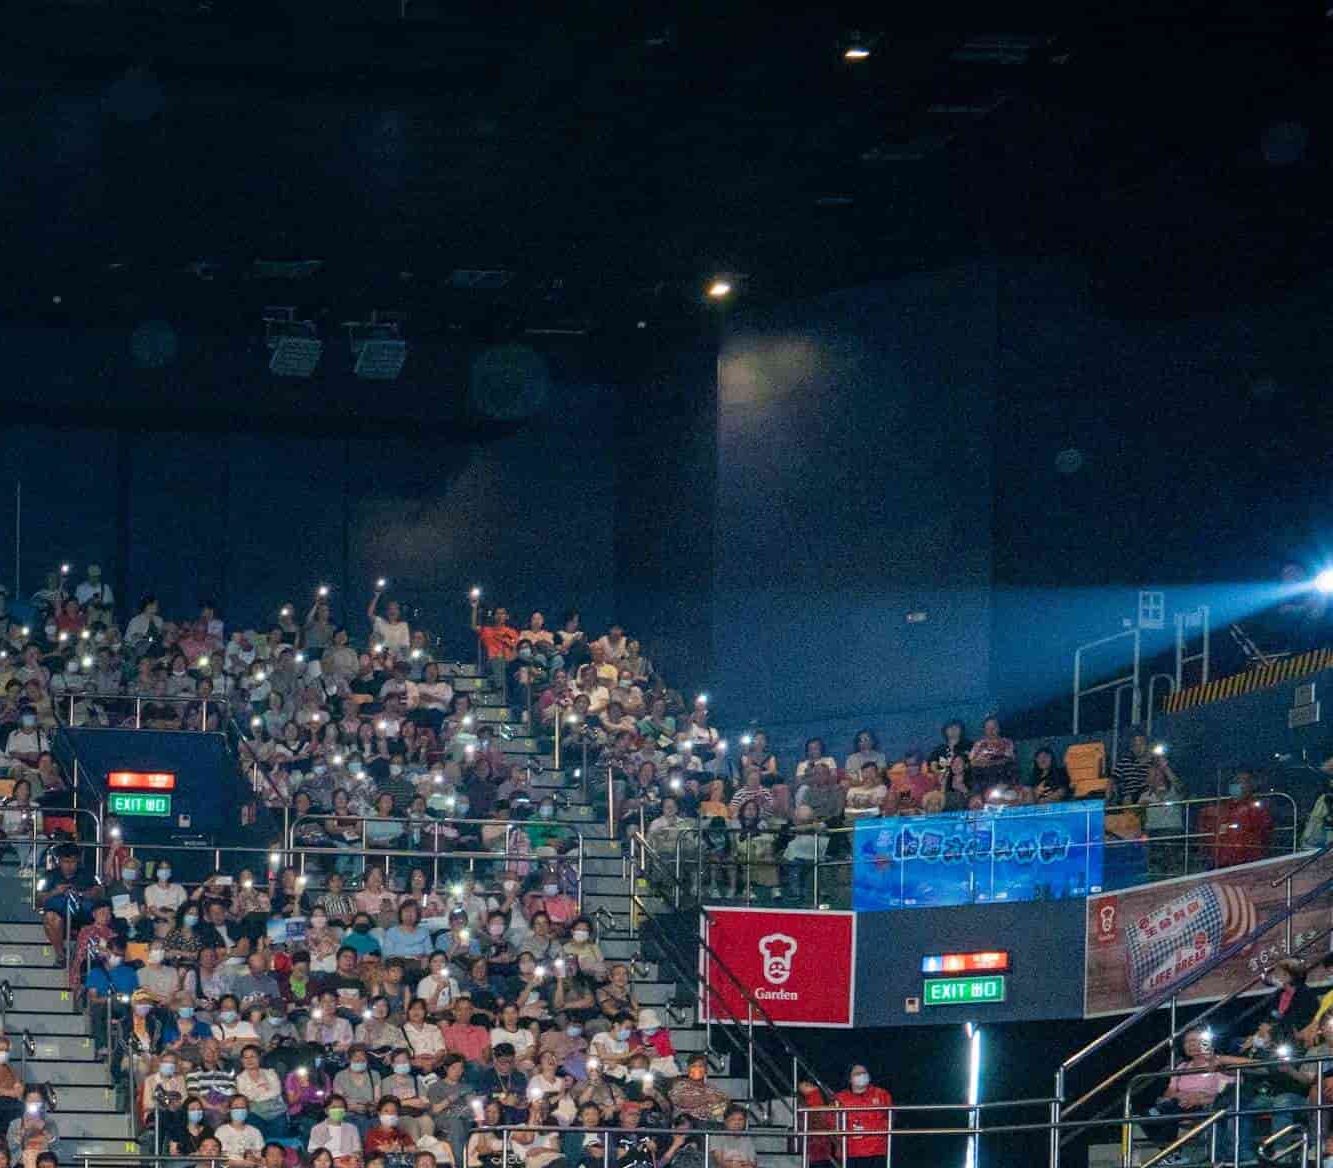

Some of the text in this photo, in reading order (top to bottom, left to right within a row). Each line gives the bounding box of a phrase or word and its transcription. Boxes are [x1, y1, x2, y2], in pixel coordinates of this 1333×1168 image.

[116, 797, 141, 811] EXIT
[1149, 969, 1173, 988] LIFE
[755, 987, 798, 1001] Garden
[931, 982, 967, 1000] EXIT
